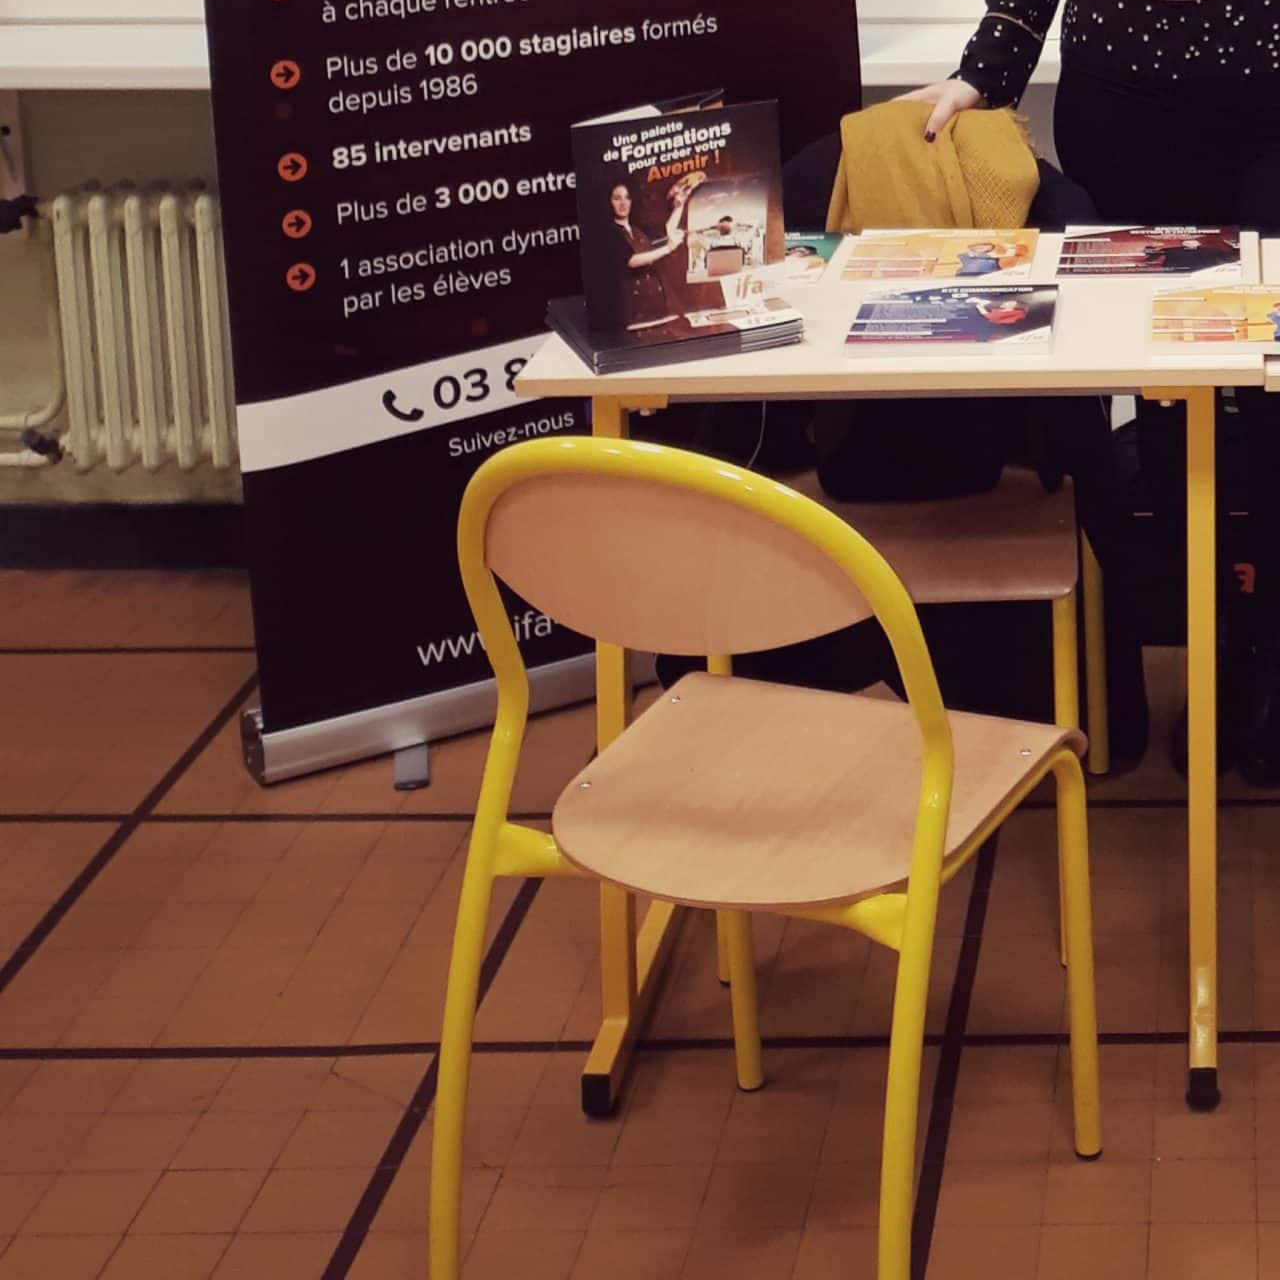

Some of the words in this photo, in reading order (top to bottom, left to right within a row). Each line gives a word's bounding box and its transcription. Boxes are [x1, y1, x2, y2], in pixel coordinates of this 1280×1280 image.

[322, 0, 336, 23] à
[326, 54, 378, 80] Plus
[386, 49, 417, 74] de
[424, 42, 454, 66] 10
[461, 35, 512, 62] 000
[519, 22, 636, 56] stagiaires
[642, 13, 718, 41] formés
[328, 81, 412, 115] depuis
[419, 73, 478, 101] 1986
[332, 144, 367, 170] 85
[374, 122, 532, 164] intervenants
[621, 122, 732, 163] Formations
[628, 157, 657, 173] pour
[647, 154, 709, 182] Avenir
[337, 198, 389, 225] Plus
[396, 191, 428, 216] de
[435, 187, 451, 210] 3
[458, 178, 509, 205] 000
[340, 257, 351, 281] 1
[357, 235, 494, 278] association
[343, 289, 385, 318] par
[391, 281, 426, 307] les
[433, 266, 512, 299] élèves
[735, 277, 764, 298] ifa
[433, 367, 491, 410] 03
[449, 411, 575, 457] Suivez-nous
